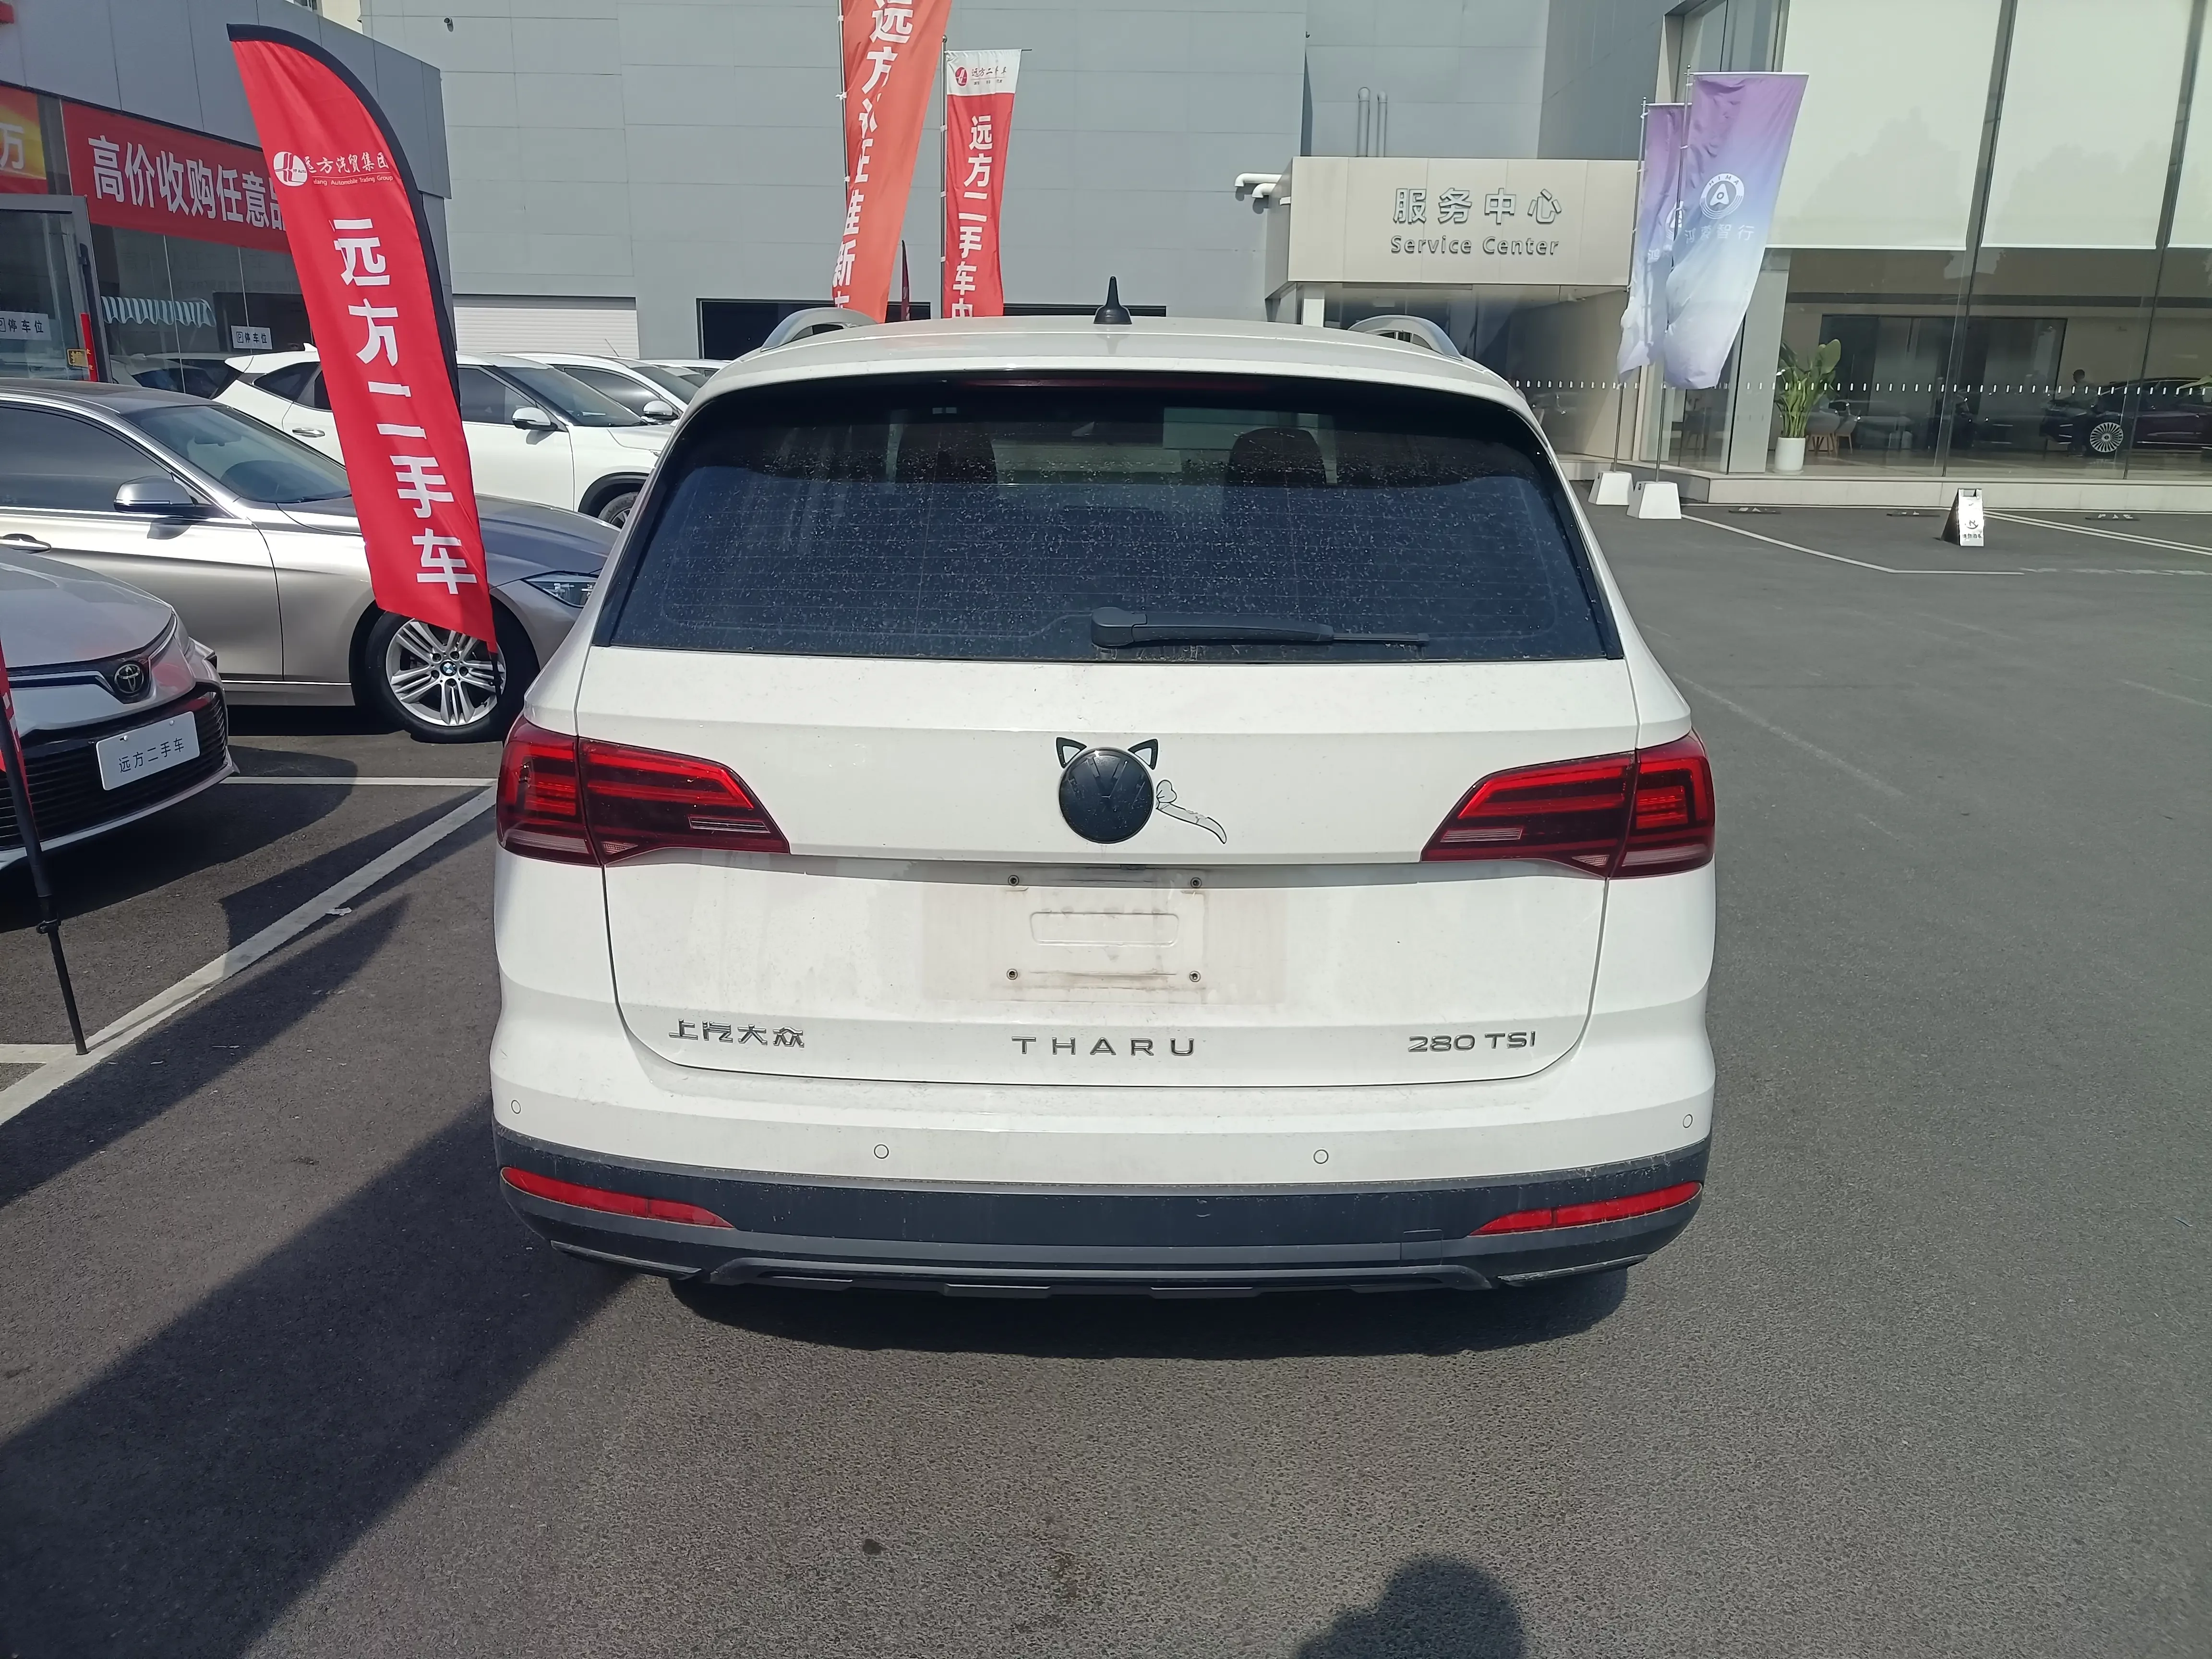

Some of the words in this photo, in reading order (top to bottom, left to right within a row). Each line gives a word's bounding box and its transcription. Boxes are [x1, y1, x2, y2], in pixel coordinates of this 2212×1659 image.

[1708, 175, 1739, 186] HIMA
[1393, 187, 1562, 226] 服务中心
[1391, 235, 1472, 254] Service
[1482, 236, 1559, 255] Center
[8, 319, 44, 333] 停车位
[245, 332, 267, 343] 停车位
[332, 218, 477, 595] 远方二手车
[119, 738, 184, 773] 远方二手车
[669, 1019, 805, 1048] 上汽大众
[1408, 1034, 1475, 1052] 280
[1484, 1031, 1536, 1049] TSI
[1011, 1036, 1194, 1056] THARU
